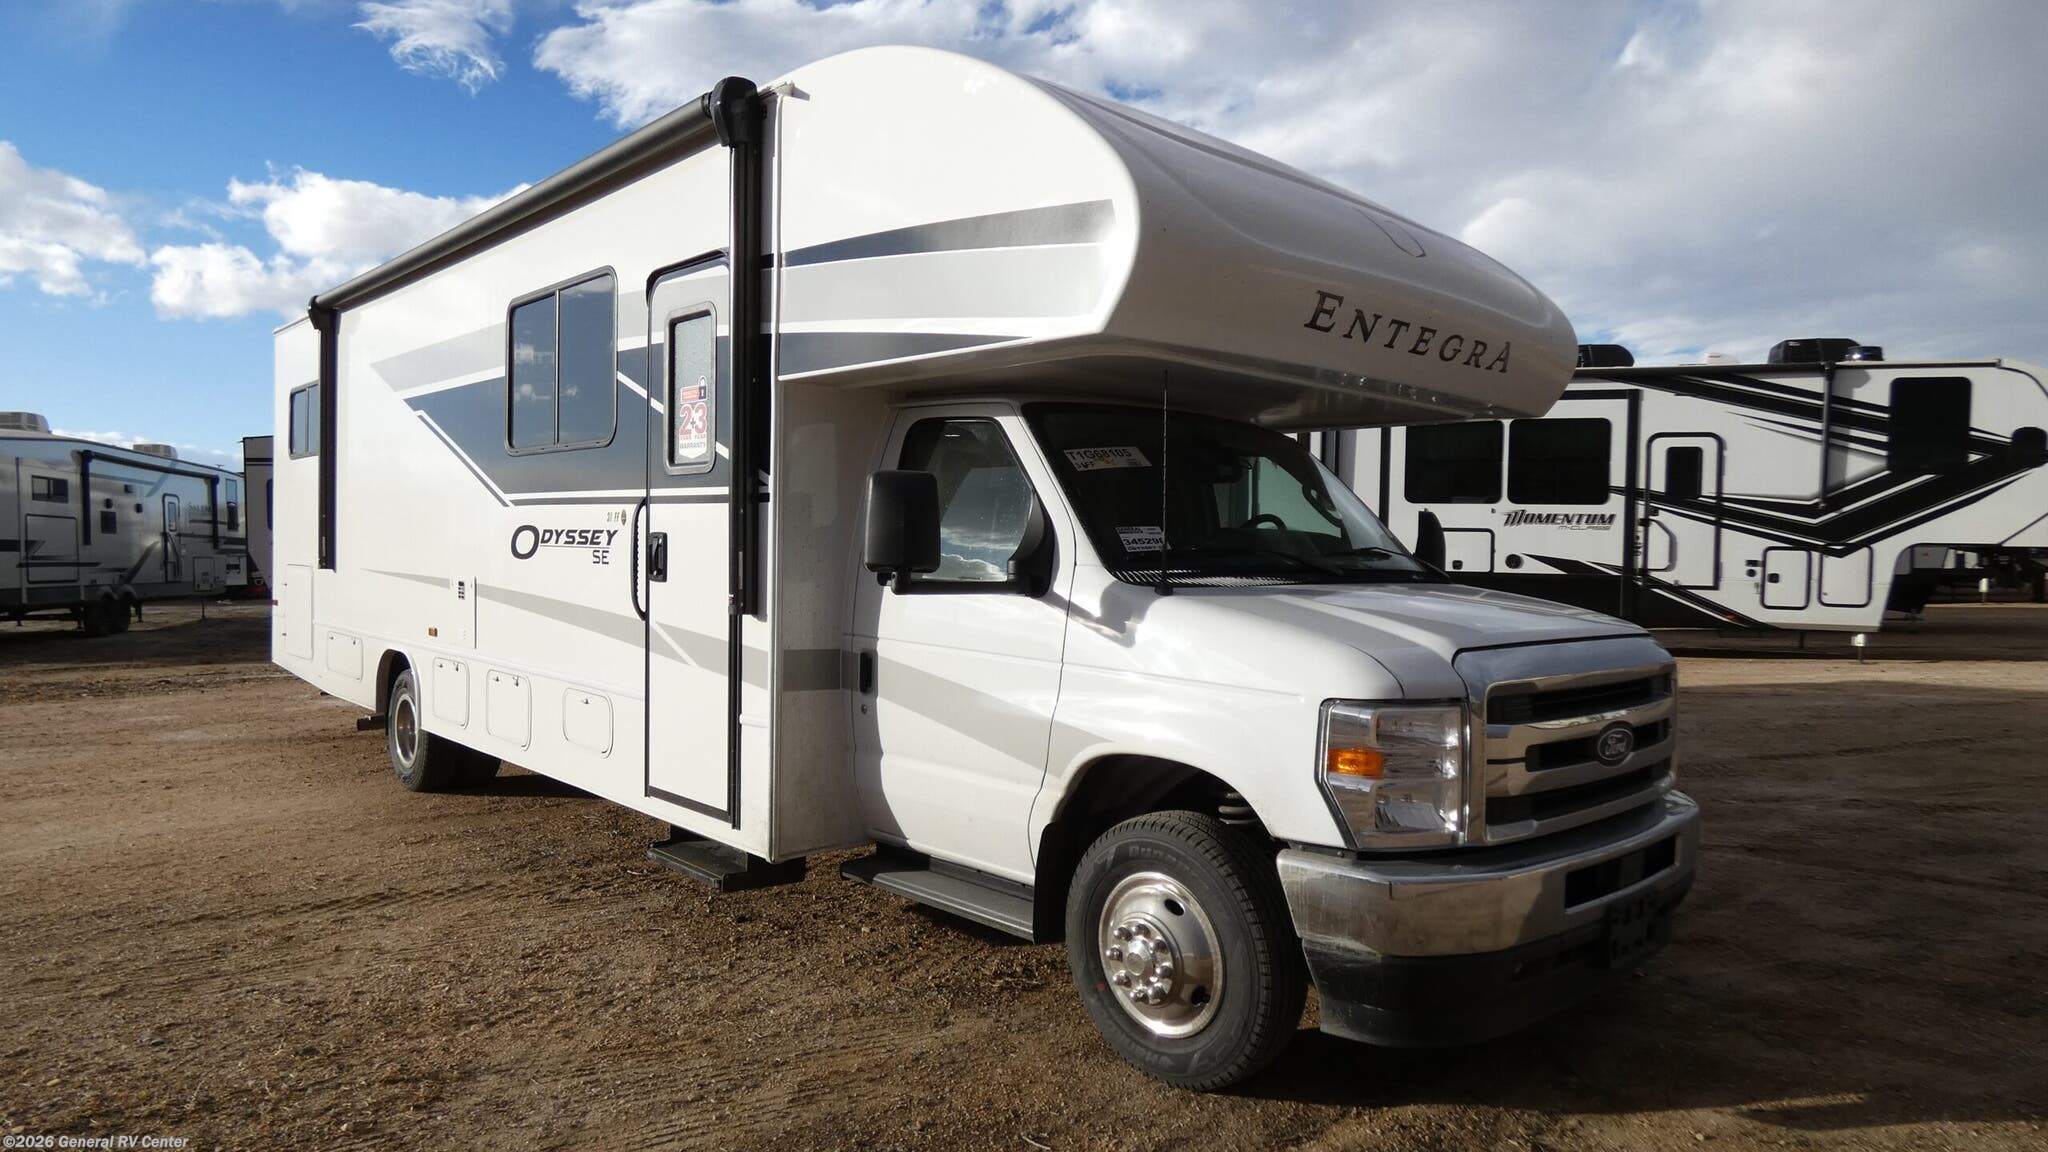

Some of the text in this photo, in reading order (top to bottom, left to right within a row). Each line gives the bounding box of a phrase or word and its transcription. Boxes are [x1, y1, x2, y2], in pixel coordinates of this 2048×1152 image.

[1303, 290, 1511, 374] ENTEGRA
[1502, 509, 1617, 527] MOMENTUM
[510, 524, 619, 560] ODYSSEY
[592, 550, 610, 565] SE
